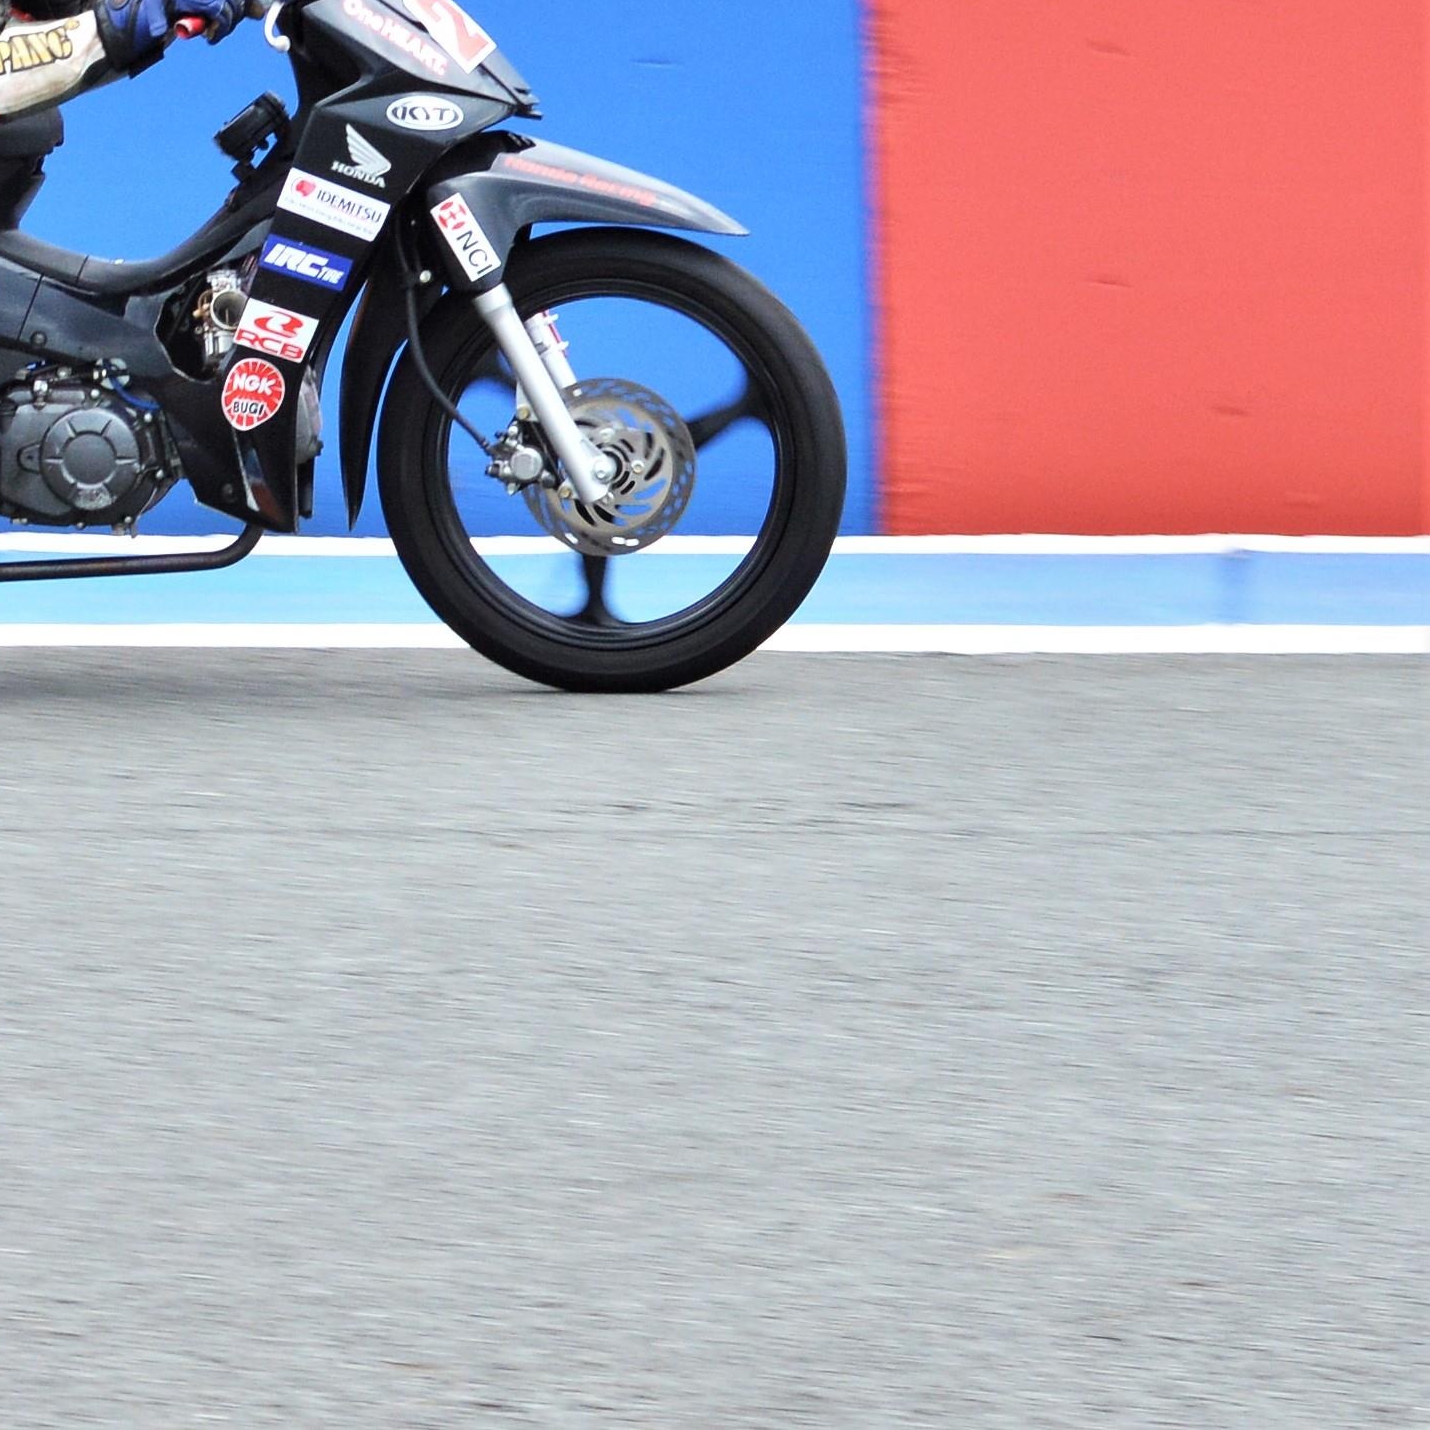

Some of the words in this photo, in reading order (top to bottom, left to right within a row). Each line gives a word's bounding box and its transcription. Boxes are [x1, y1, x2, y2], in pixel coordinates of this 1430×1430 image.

[331, 160, 386, 189] HONDA
[317, 189, 382, 224] IDEMITSU
[263, 242, 329, 278] IRC
[456, 230, 493, 276] NCI
[236, 328, 304, 359] RCB
[232, 373, 276, 396] NGK
[233, 401, 265, 415] BUGI
